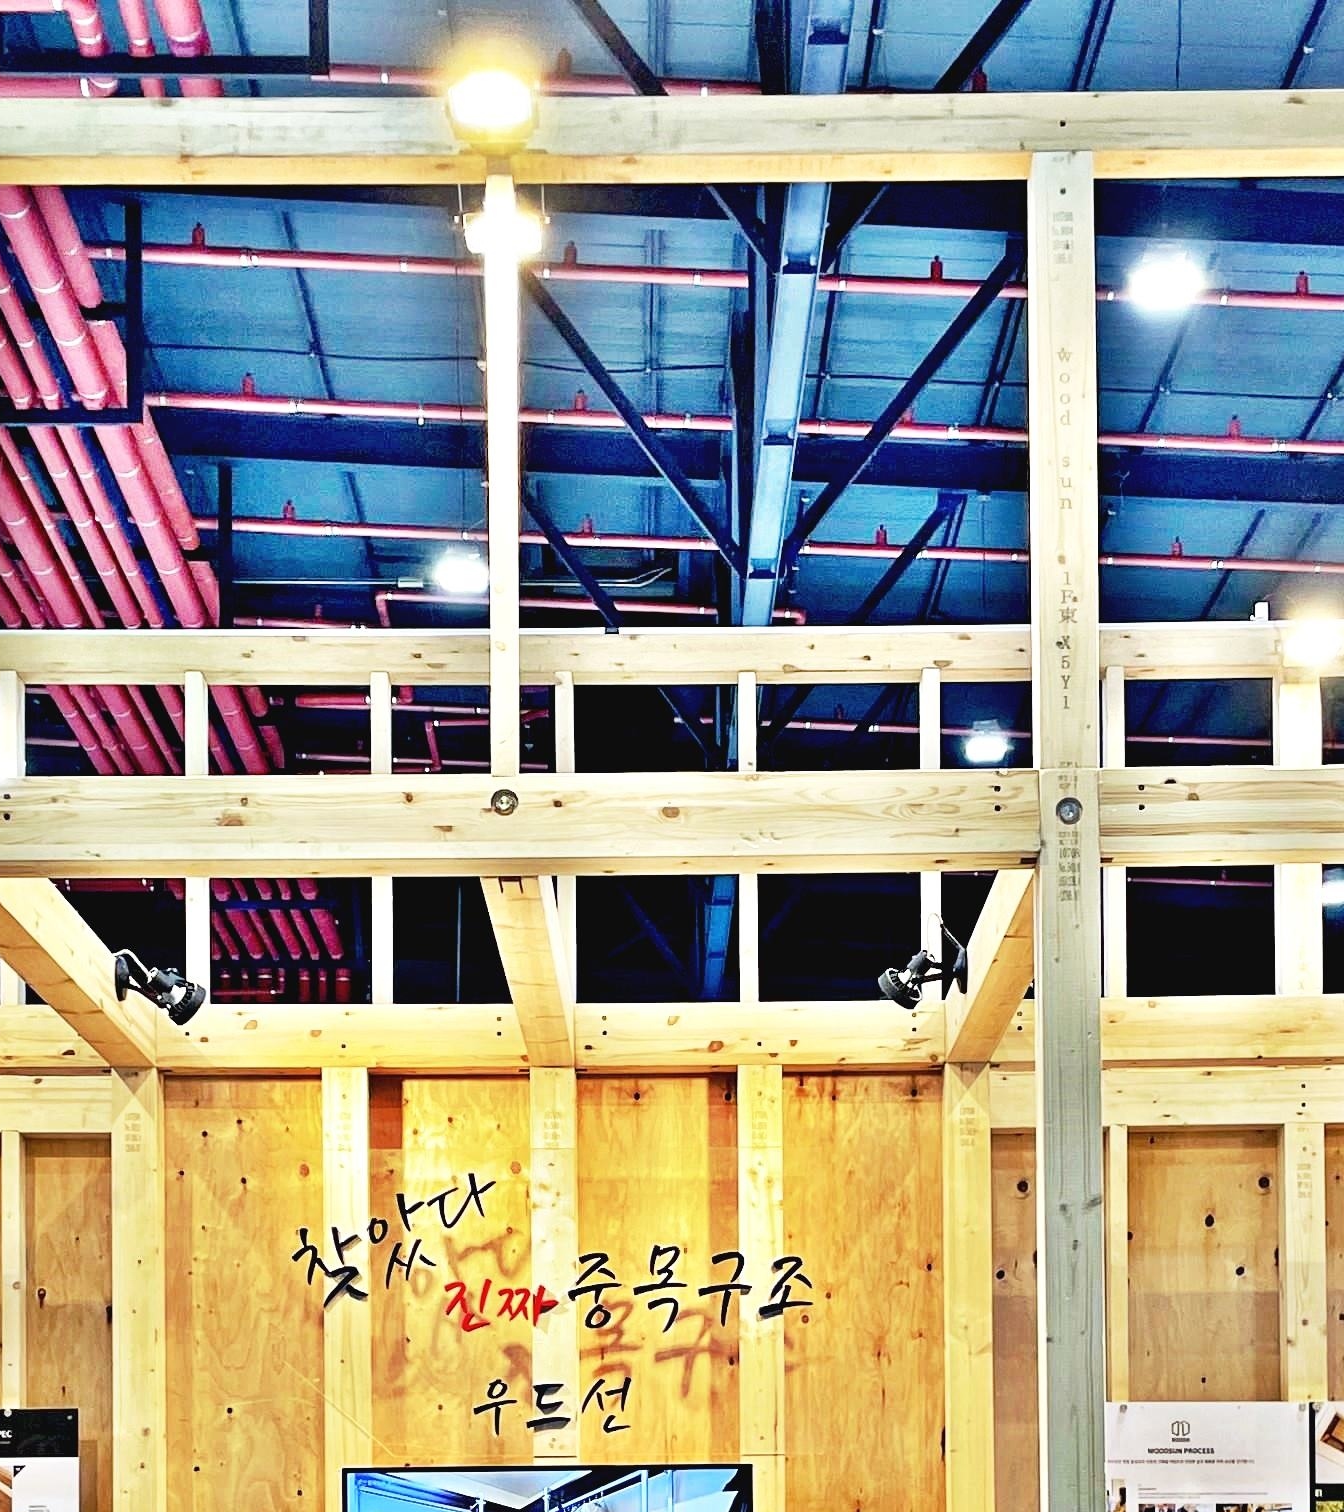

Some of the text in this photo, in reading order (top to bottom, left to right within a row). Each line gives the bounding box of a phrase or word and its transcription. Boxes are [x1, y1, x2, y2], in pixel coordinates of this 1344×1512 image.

[1056, 346, 1073, 427] wood
[1058, 455, 1073, 510] sun
[291, 1173, 496, 1309] 찾았다
[444, 1245, 815, 1334] 진짜 중목구조
[473, 1377, 633, 1437] 우드선
